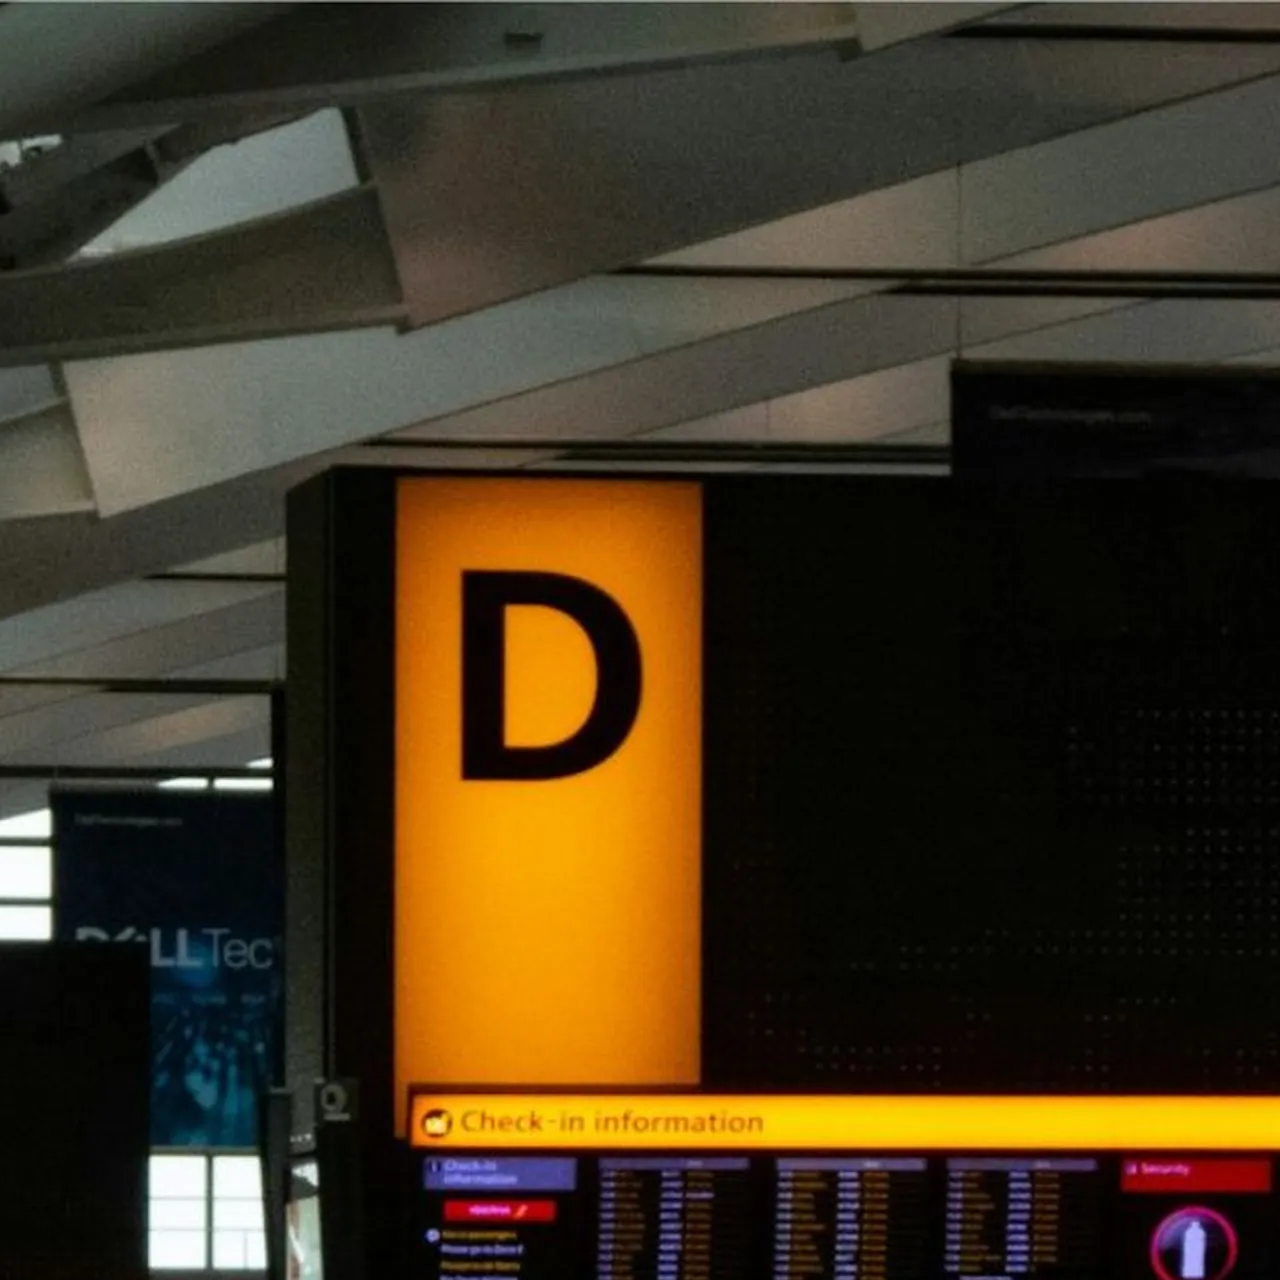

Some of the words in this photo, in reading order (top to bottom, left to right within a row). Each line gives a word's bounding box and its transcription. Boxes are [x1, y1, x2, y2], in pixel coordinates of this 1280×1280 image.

[460, 568, 643, 782] D
[460, 1109, 586, 1134] Check-in
[594, 1108, 764, 1134] information
